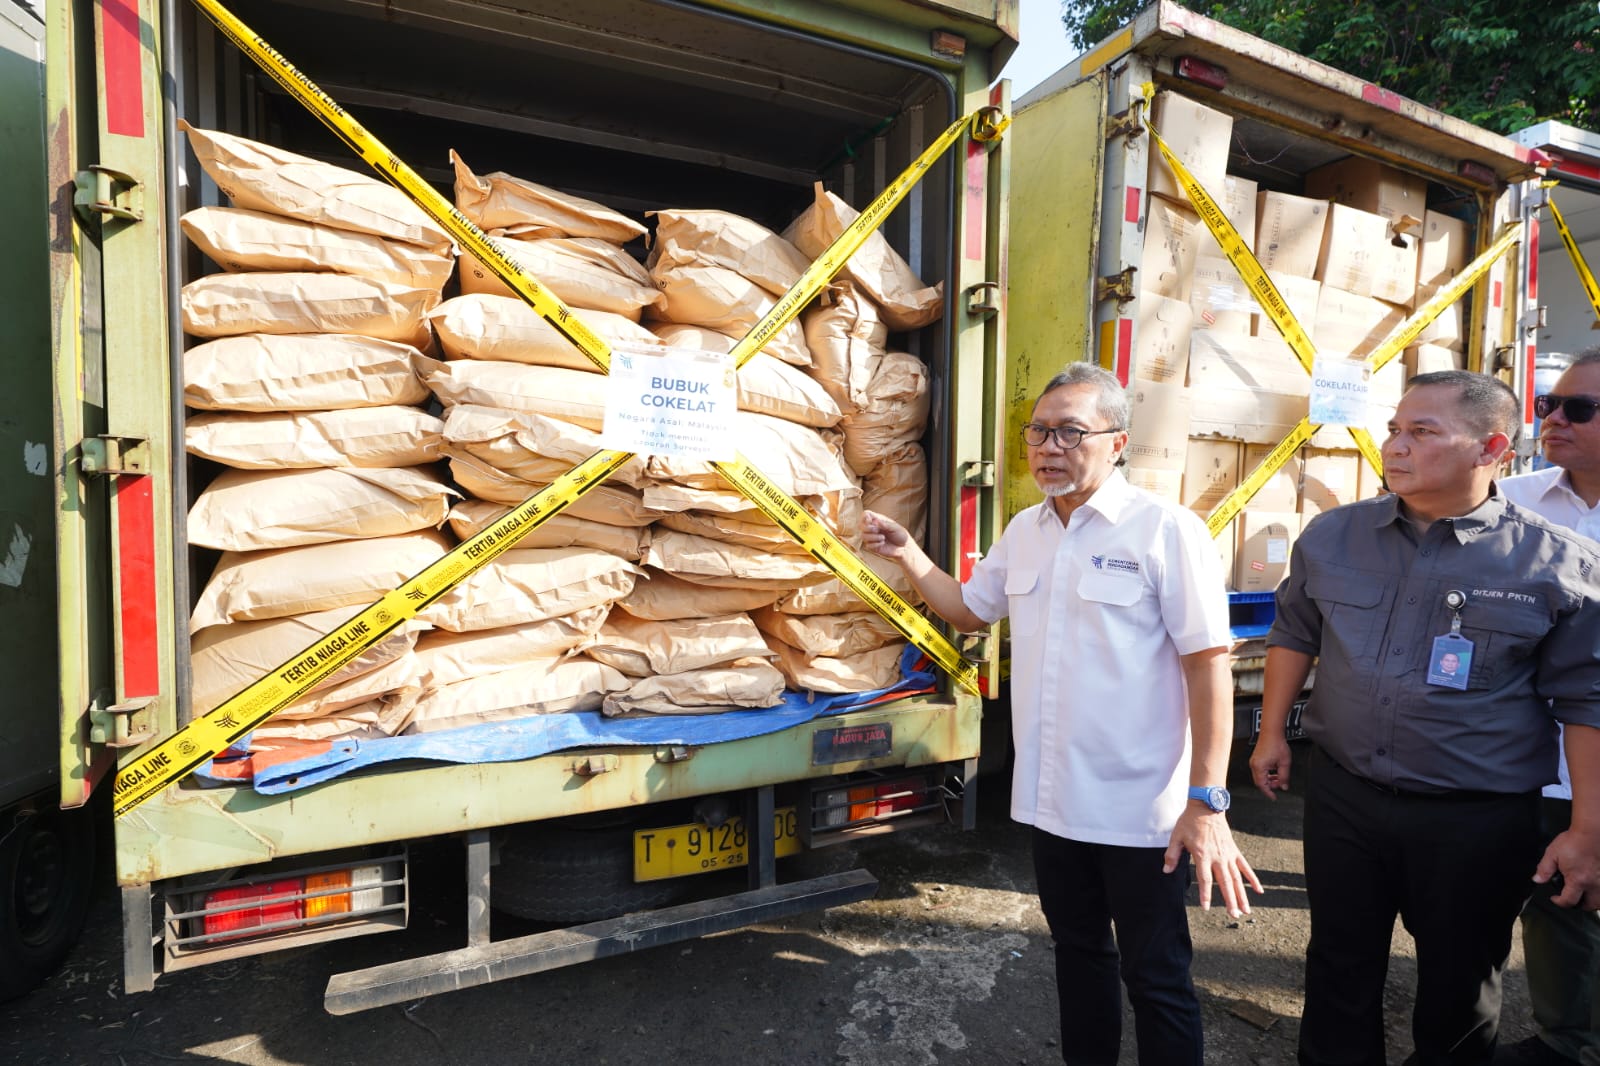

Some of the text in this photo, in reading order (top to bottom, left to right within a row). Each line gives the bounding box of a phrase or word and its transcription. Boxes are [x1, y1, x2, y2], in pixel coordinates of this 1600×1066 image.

[447, 204, 526, 276] TERTIB NIAGA LINE
[640, 394, 716, 413] COKELAT
[651, 376, 710, 395] BUBUK
[1315, 378, 1351, 391] COKELAT
[618, 412, 656, 424] Negara
[740, 466, 767, 490] TERTIB
[762, 485, 786, 507] NIAGA
[781, 502, 800, 520] LINE
[462, 533, 496, 561] TERTIB
[492, 516, 522, 540] NIAGA
[518, 503, 541, 522] LINE
[855, 569, 878, 590] TERTIB
[874, 586, 894, 605] NIAGA
[890, 600, 907, 616] LINE
[1472, 589, 1536, 604] DITJEN PKTN
[279, 619, 370, 685] TERTIB NIAGA LINE
[114, 750, 171, 797] NIAGA LINE
[641, 834, 655, 863] T
[687, 820, 747, 857] 9128
